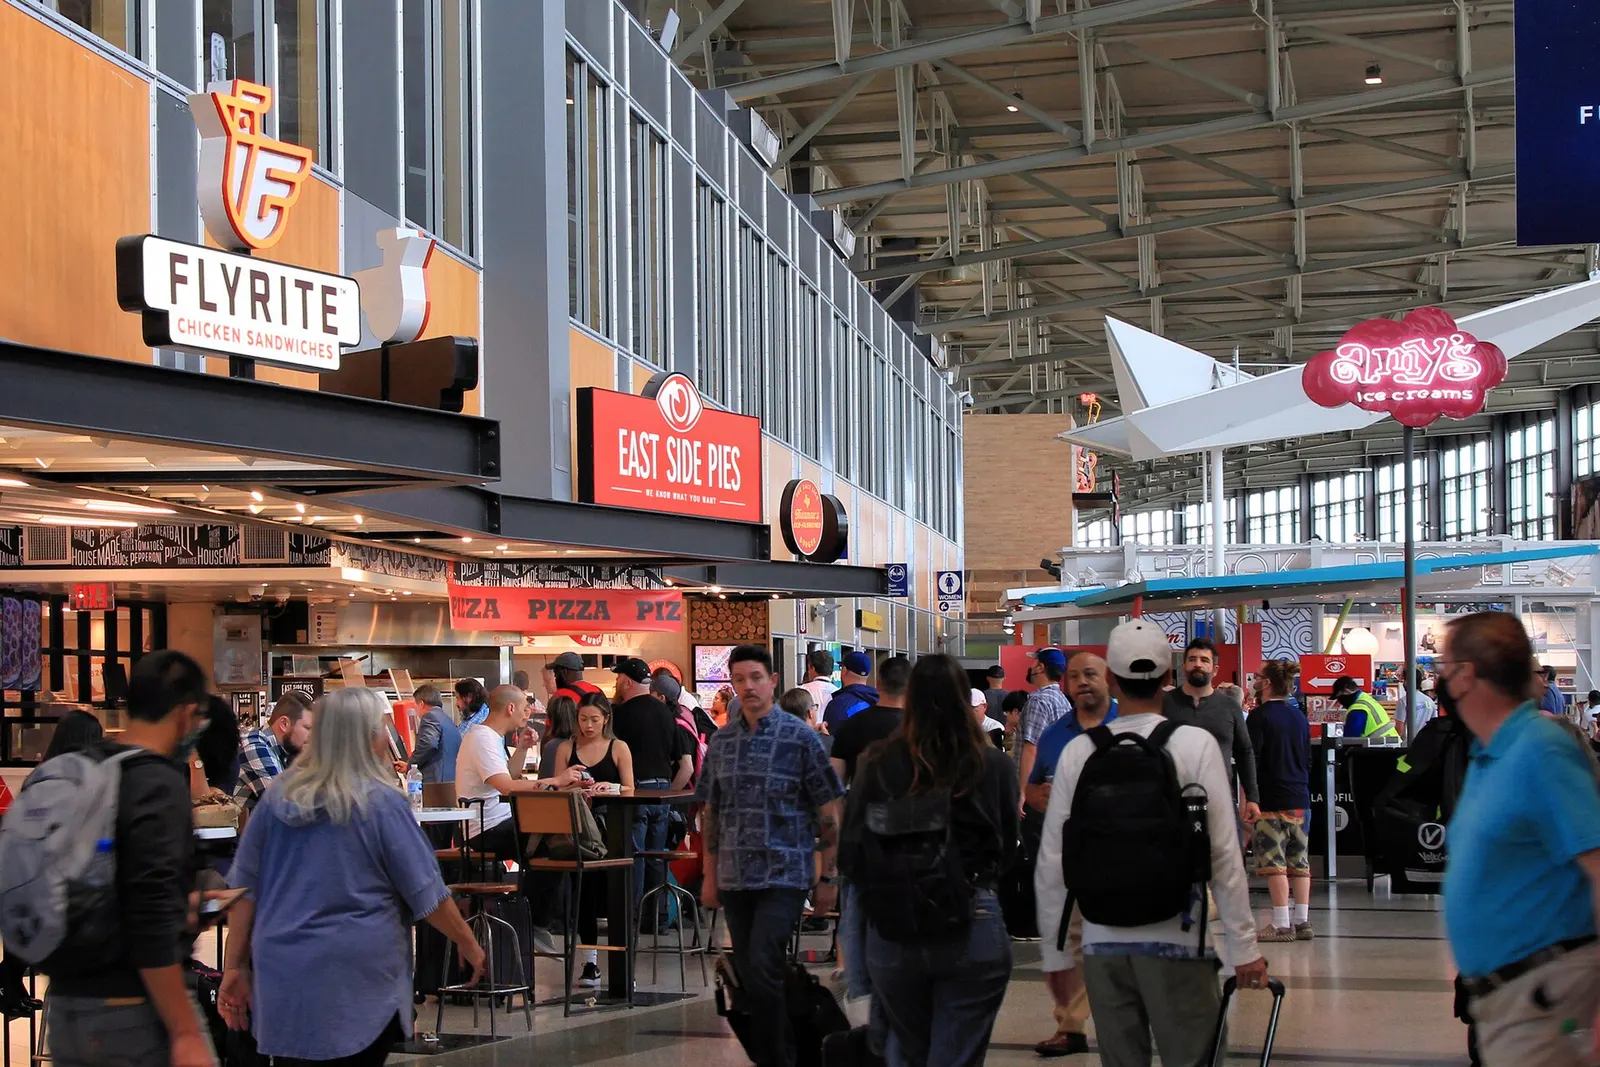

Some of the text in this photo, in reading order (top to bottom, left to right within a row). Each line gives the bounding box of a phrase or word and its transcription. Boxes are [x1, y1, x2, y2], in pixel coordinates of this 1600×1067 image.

[1579, 105, 1600, 124] F
[169, 252, 338, 336] FLYRITE
[177, 318, 334, 360] CHICKEN SANDWICHES
[618, 428, 741, 492] EAST SIDE PIES
[655, 490, 671, 499] KNOW
[672, 492, 687, 501] WHAT
[689, 494, 701, 503] YOU
[135, 538, 164, 551] TOMATOES
[197, 540, 240, 565] HOUSEMA
[164, 546, 183, 563] PIZZA
[461, 562, 479, 581] PIZZA
[452, 596, 680, 621] PIZZA PIZZA PIZ
[281, 683, 293, 695] EAST
[303, 683, 315, 695] PIES
[1313, 698, 1347, 711] PIZ
[1311, 793, 1354, 802] LAFIL
